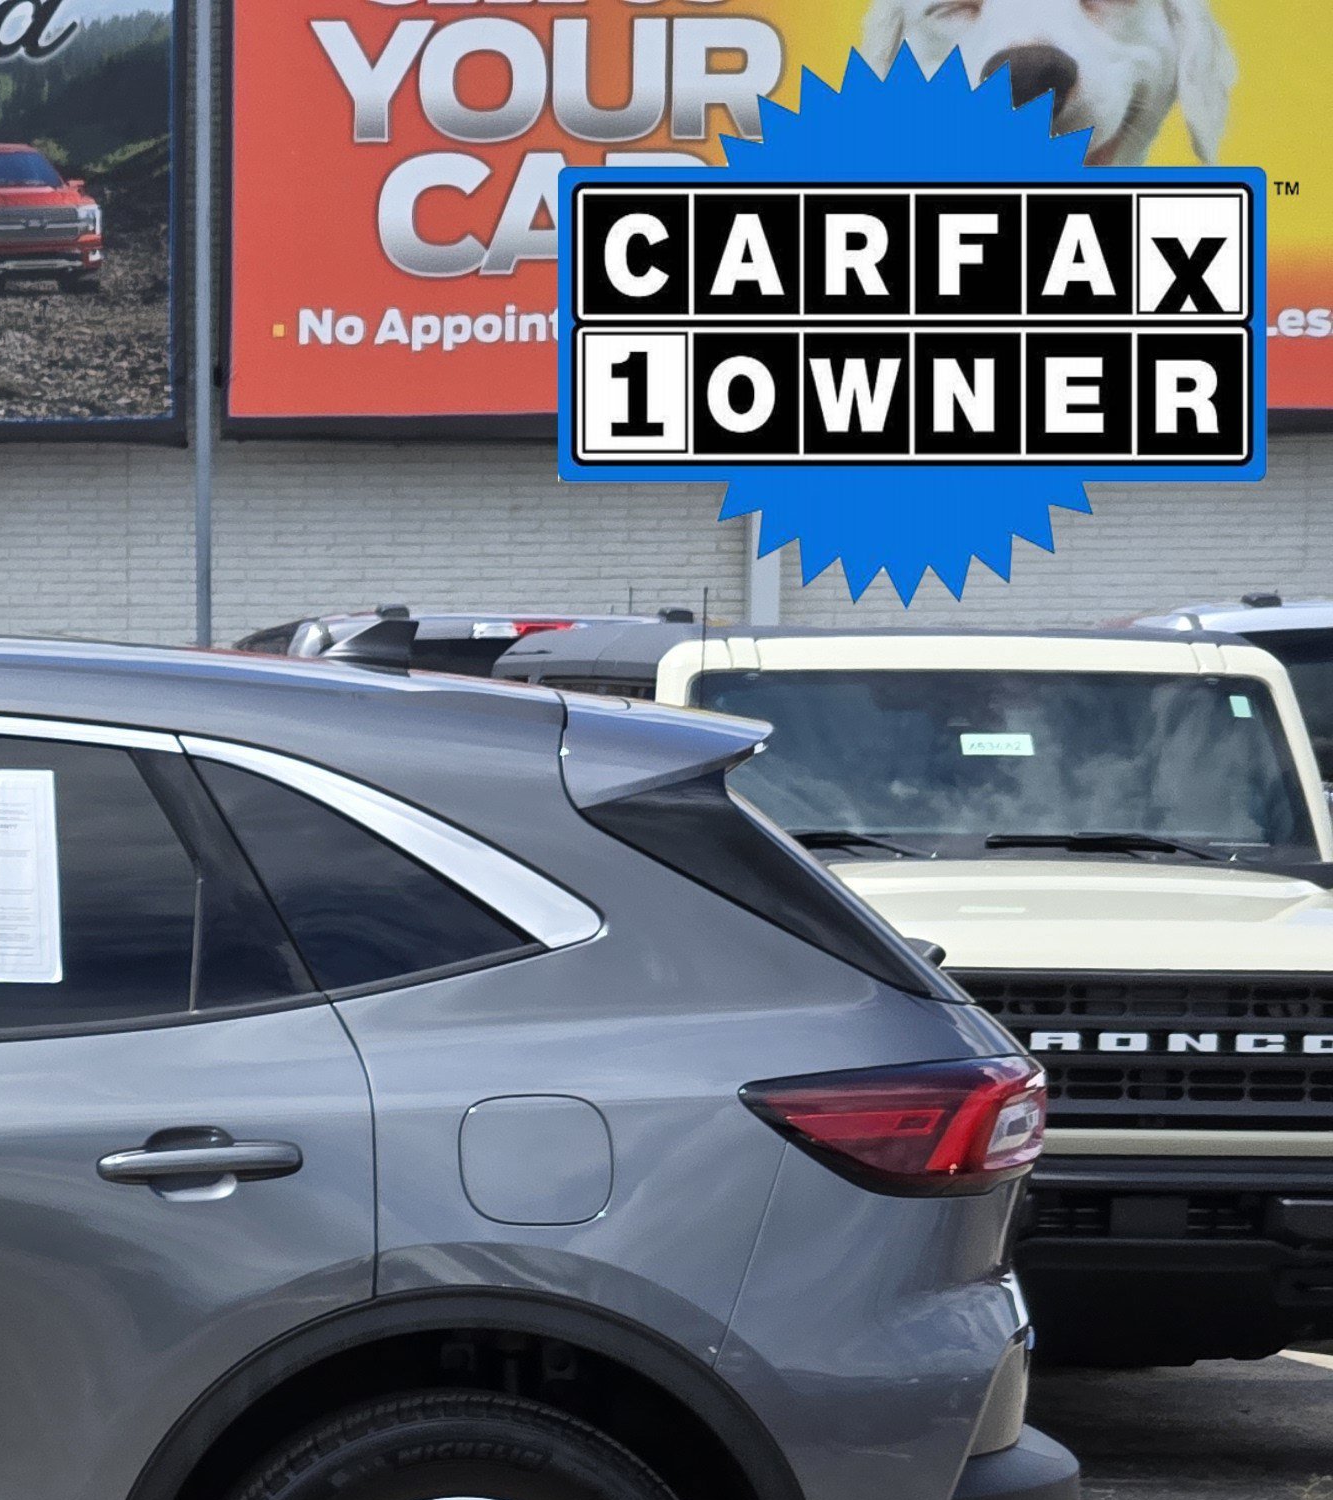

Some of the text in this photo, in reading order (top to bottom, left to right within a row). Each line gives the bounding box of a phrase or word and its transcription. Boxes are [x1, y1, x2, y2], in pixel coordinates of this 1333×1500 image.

[309, 16, 784, 143] YOUR
[297, 307, 366, 346] No
[1029, 1031, 1333, 1054] RONCO
